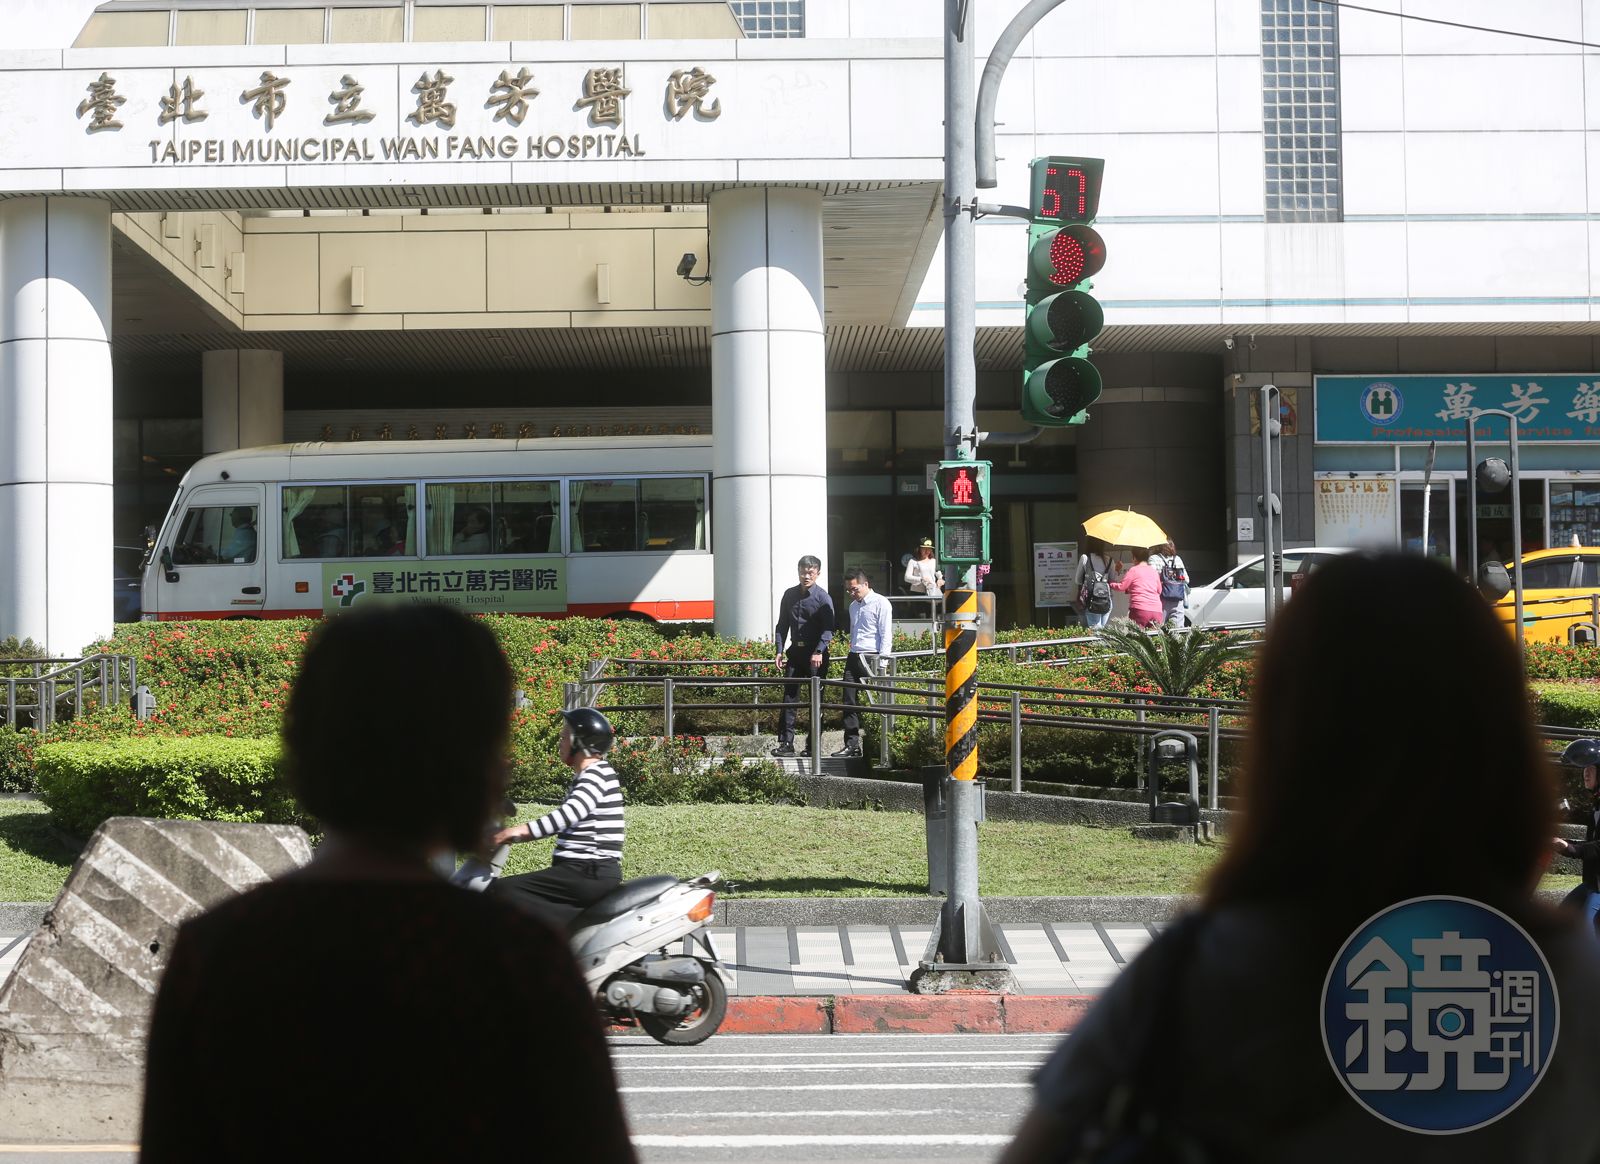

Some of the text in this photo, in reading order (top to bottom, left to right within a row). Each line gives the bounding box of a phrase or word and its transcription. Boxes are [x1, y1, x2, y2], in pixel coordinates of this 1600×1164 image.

[77, 66, 721, 134] 臺北市立萬芳醫院
[149, 133, 646, 164] TAIPEI MUNICIPAL WAN FANG HOSPITAL
[372, 569, 557, 594] 臺北市立萬芳醫院
[438, 595, 460, 606] Fang
[466, 594, 505, 605] Hospital
